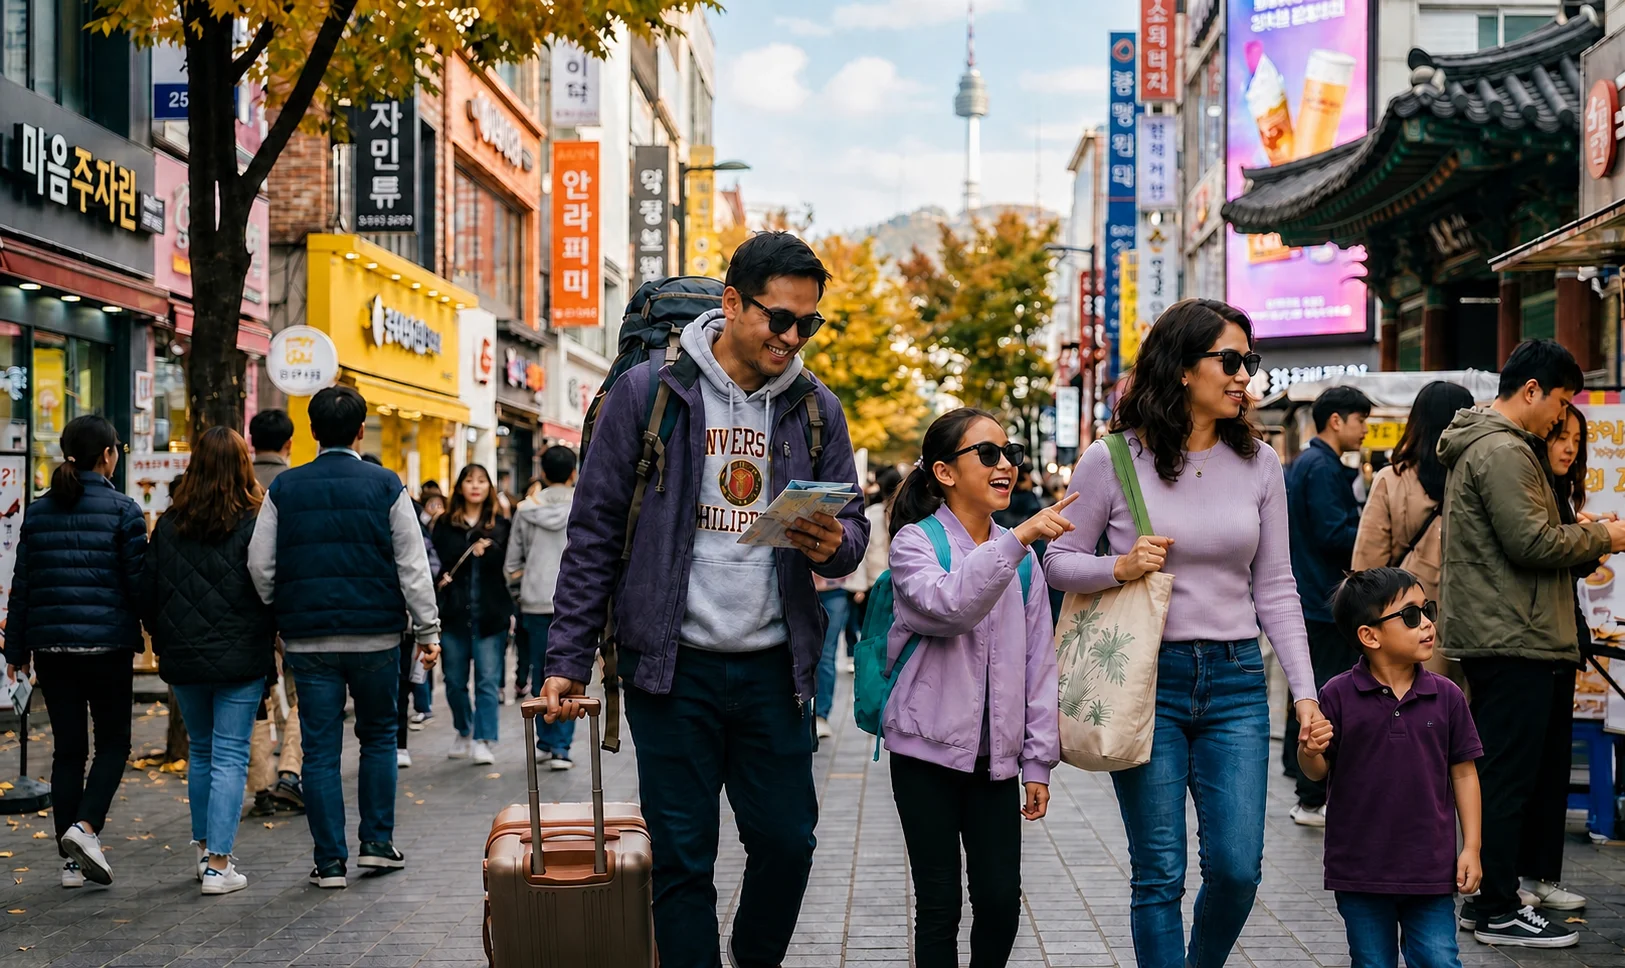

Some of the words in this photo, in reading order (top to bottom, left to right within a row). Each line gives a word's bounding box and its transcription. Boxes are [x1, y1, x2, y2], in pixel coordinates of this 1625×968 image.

[561, 169, 592, 300] 안라피미
[705, 427, 766, 458] NVERS
[698, 505, 766, 533] HILIPP
